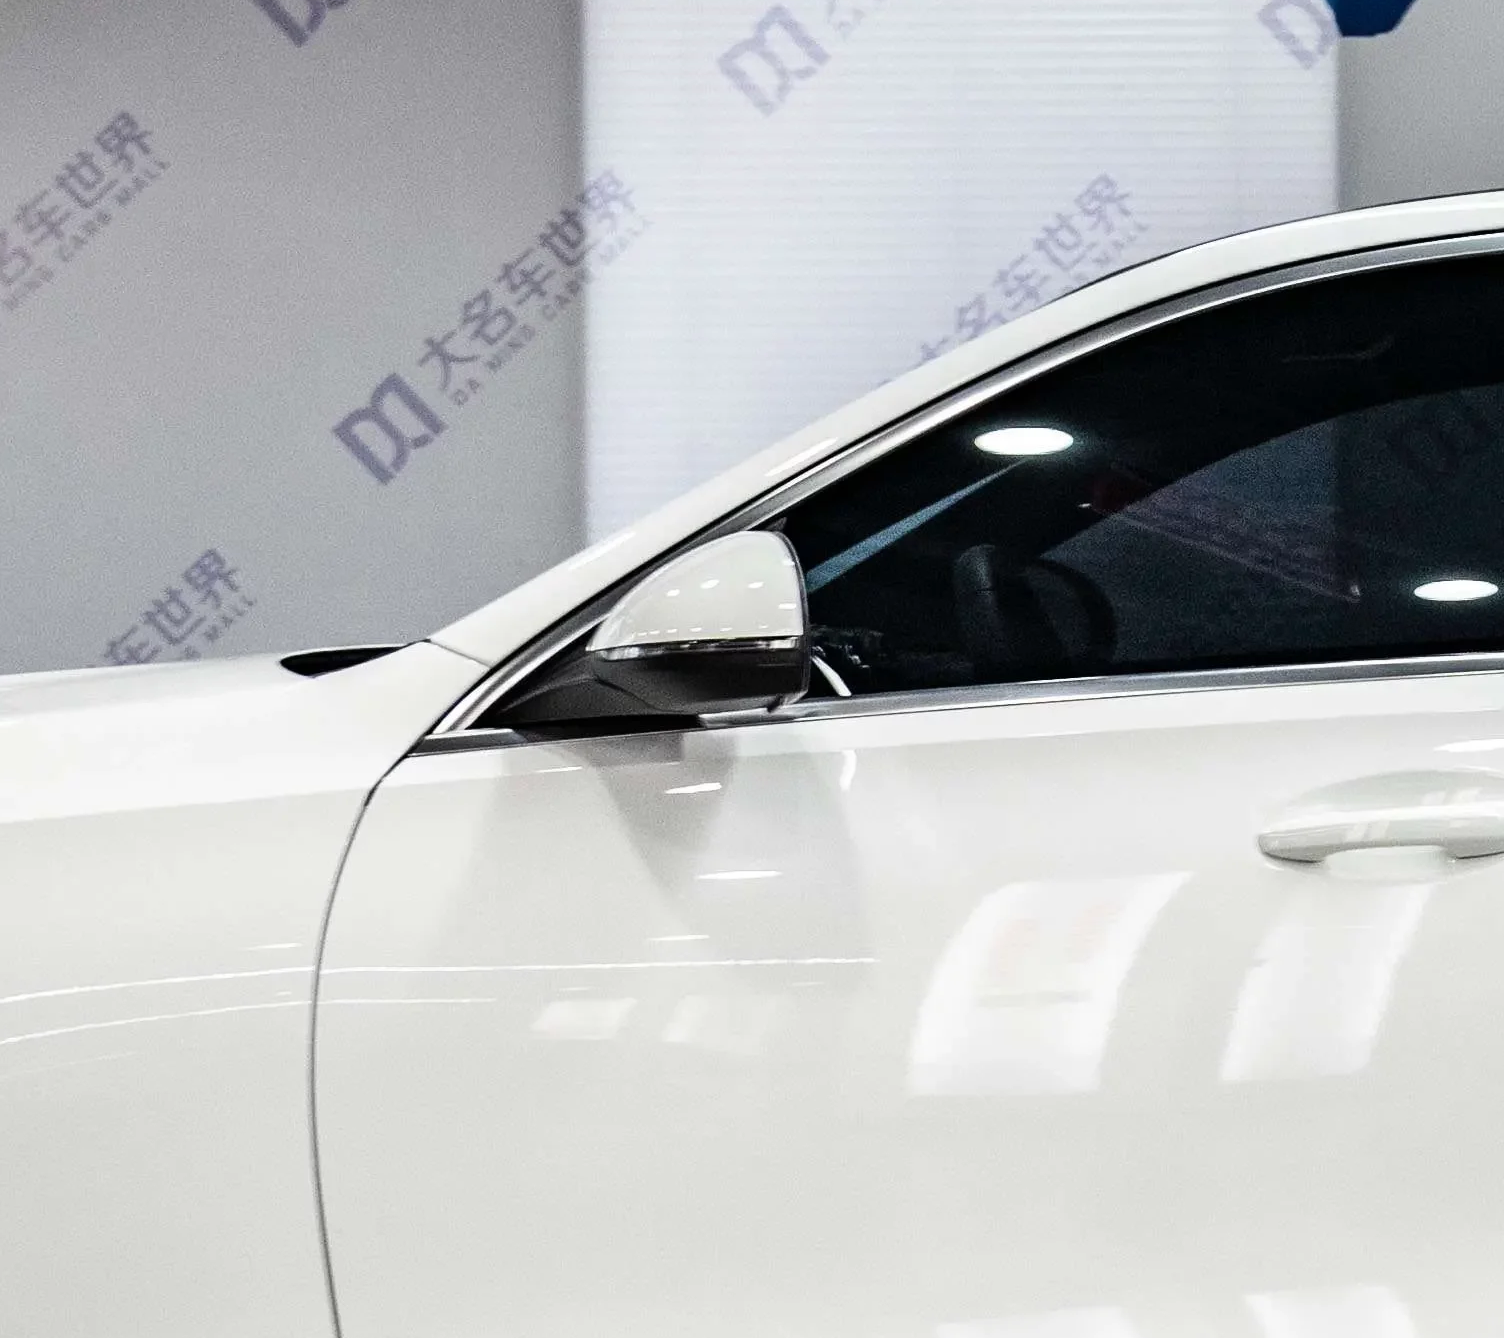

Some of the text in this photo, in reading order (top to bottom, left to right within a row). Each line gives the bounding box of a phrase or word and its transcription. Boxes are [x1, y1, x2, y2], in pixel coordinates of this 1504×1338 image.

[418, 170, 636, 393] 大名车世界
